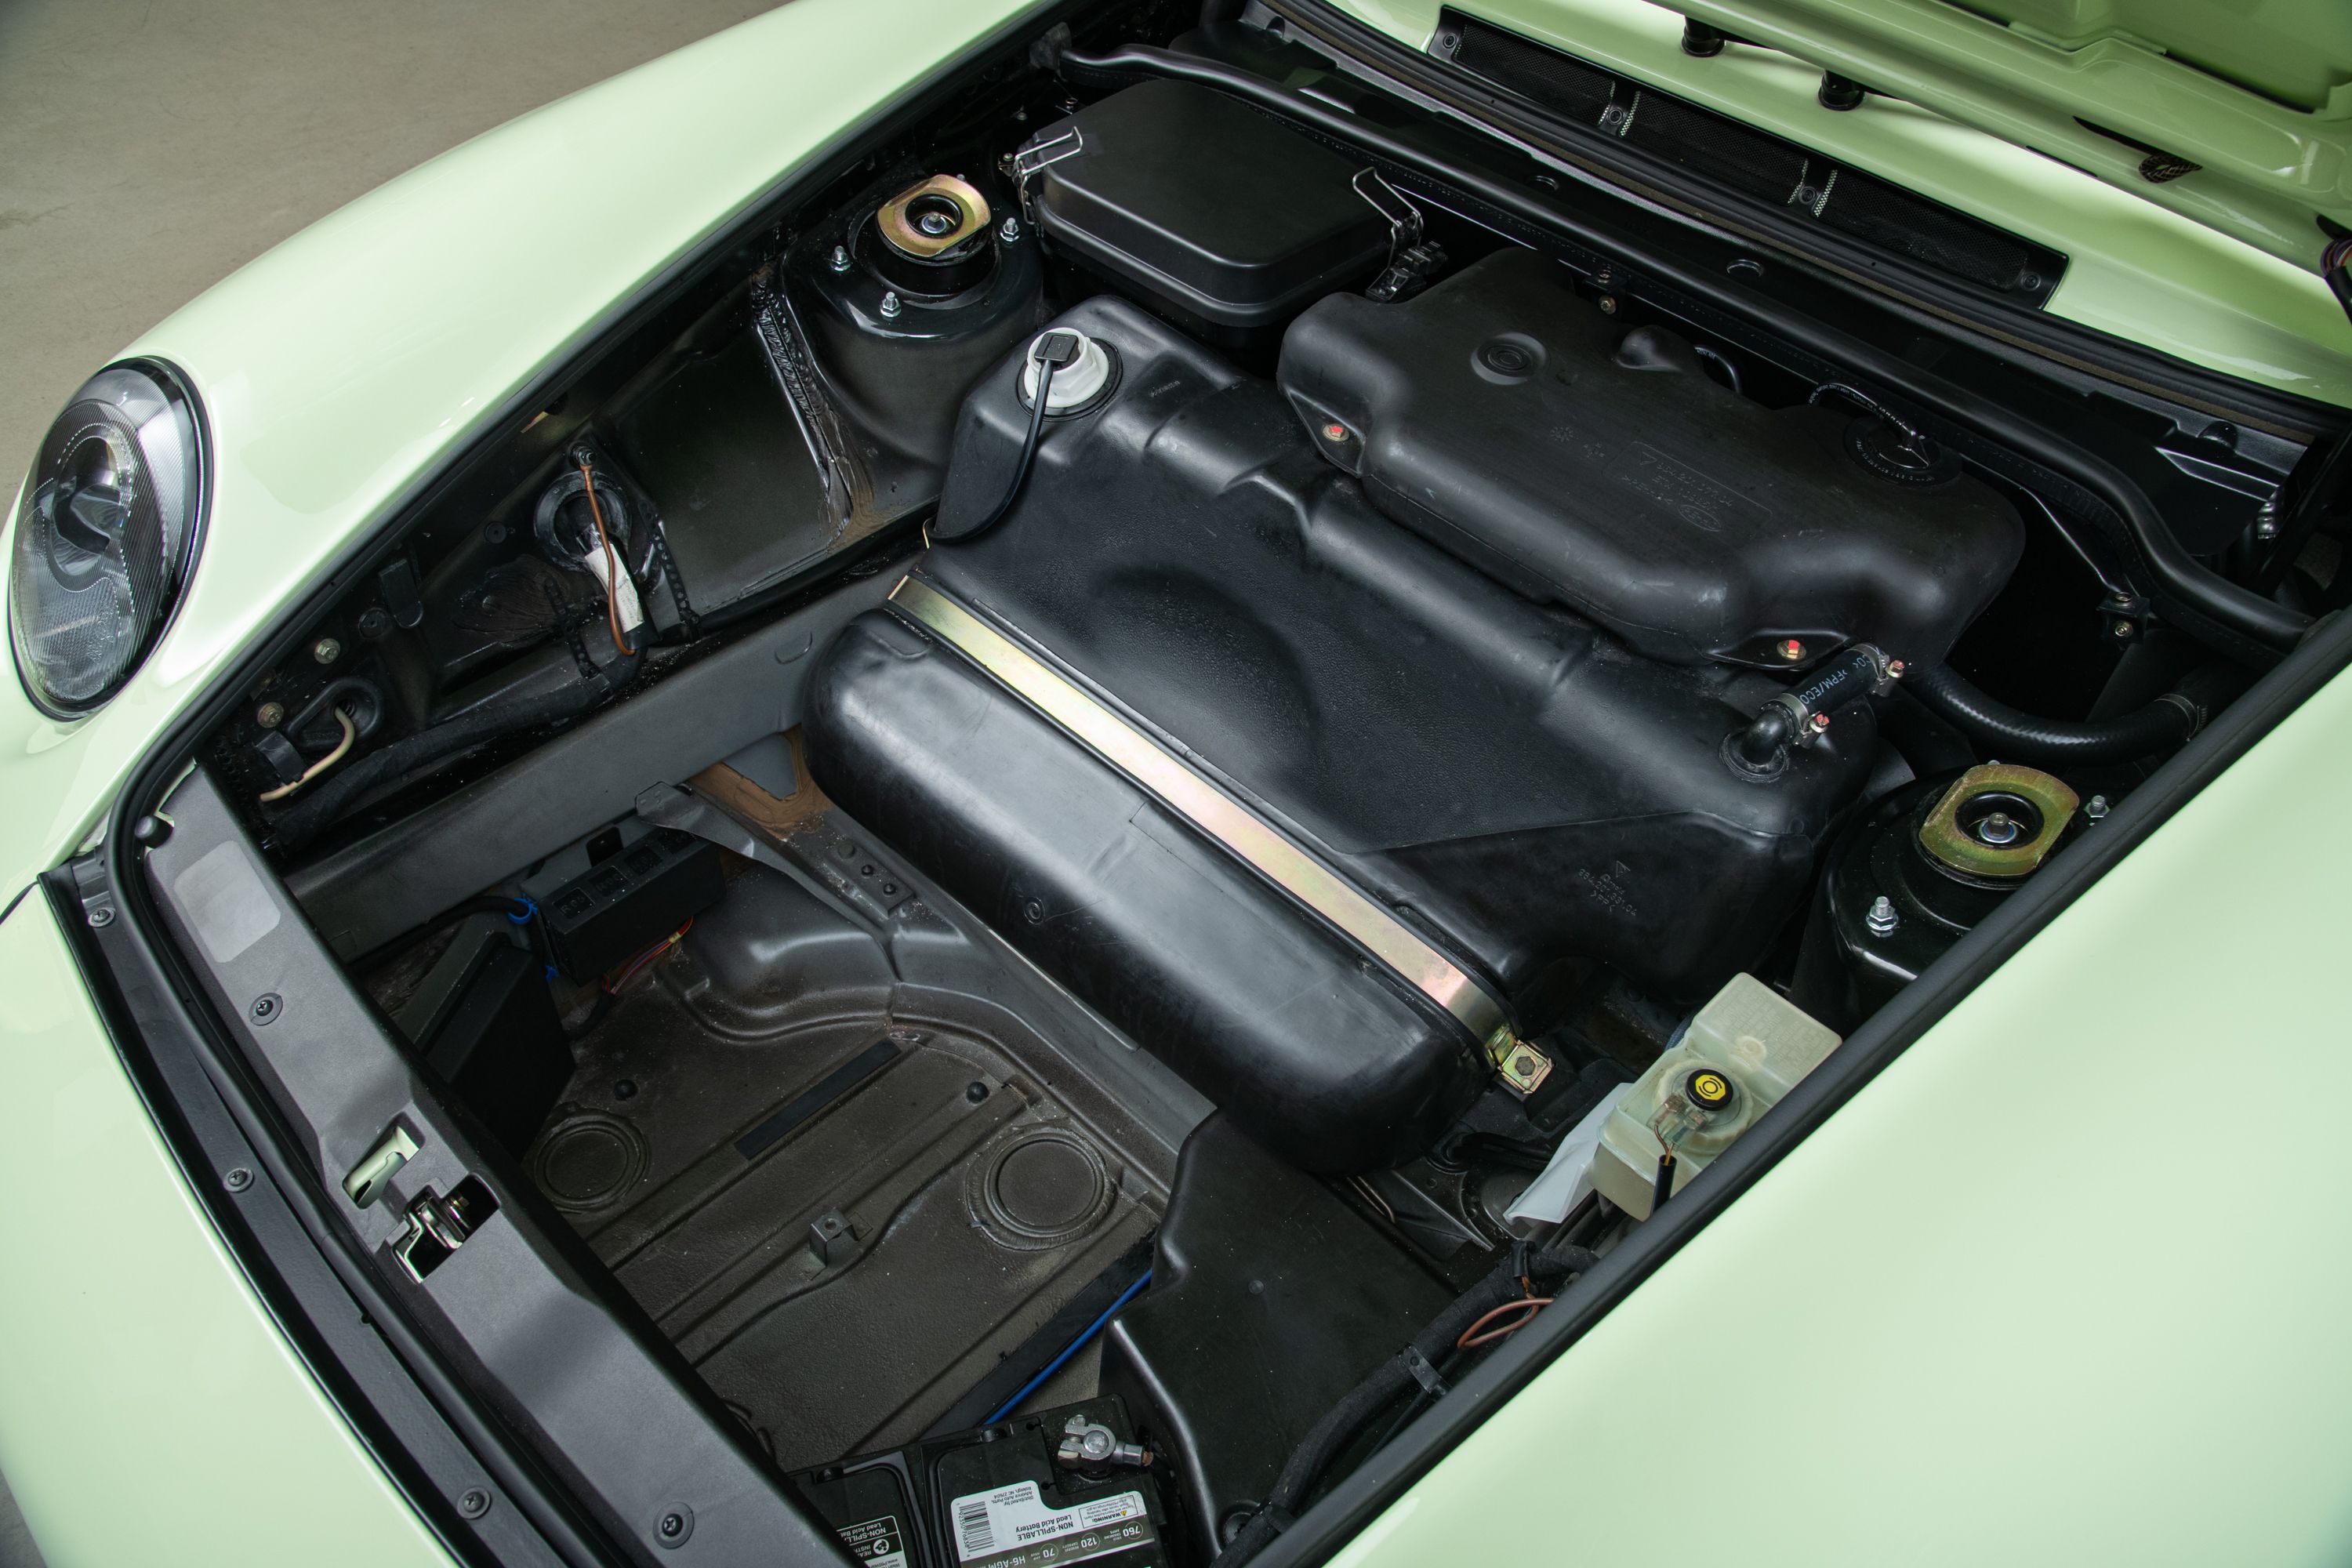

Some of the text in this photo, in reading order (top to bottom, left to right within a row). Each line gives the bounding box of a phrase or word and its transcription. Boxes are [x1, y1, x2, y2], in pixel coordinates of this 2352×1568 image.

[1091, 1512, 1120, 1523] WARNING:
[866, 1522, 881, 1531] Lead
[1014, 1514, 1072, 1534] Lead Acid Battery
[843, 1526, 887, 1544] NON-SPILL
[851, 1526, 866, 1535] Acid
[1016, 1520, 1073, 1541] NON-SPILLABLE
[1121, 1524, 1141, 1537] 760
[1080, 1536, 1098, 1548] 120
[856, 1549, 872, 1558] REA
[1041, 1546, 1055, 1559] 70
